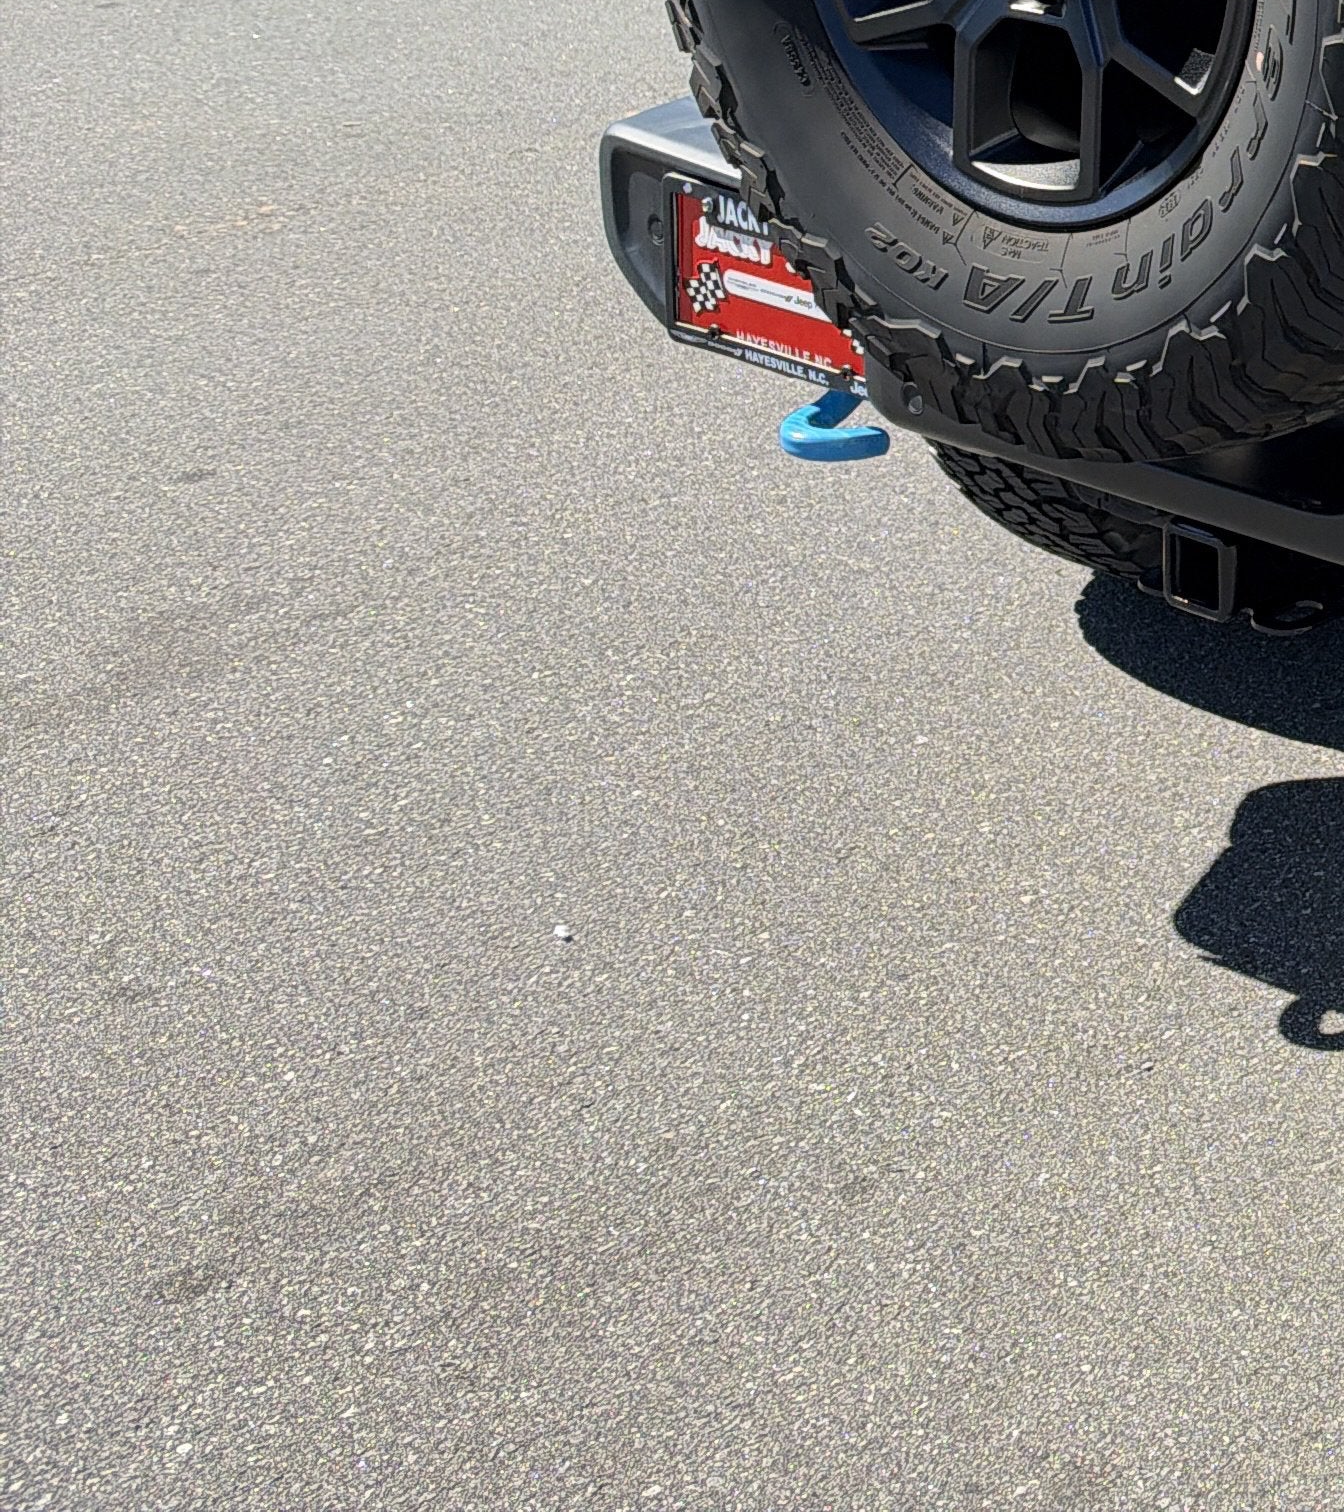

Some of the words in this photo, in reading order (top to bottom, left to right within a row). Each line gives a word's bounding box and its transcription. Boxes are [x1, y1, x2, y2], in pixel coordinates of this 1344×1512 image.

[864, 221, 950, 290] KO2
[962, 263, 1096, 324] T/A
[735, 330, 811, 363] HAYESVILLE
[850, 381, 868, 398] Je
